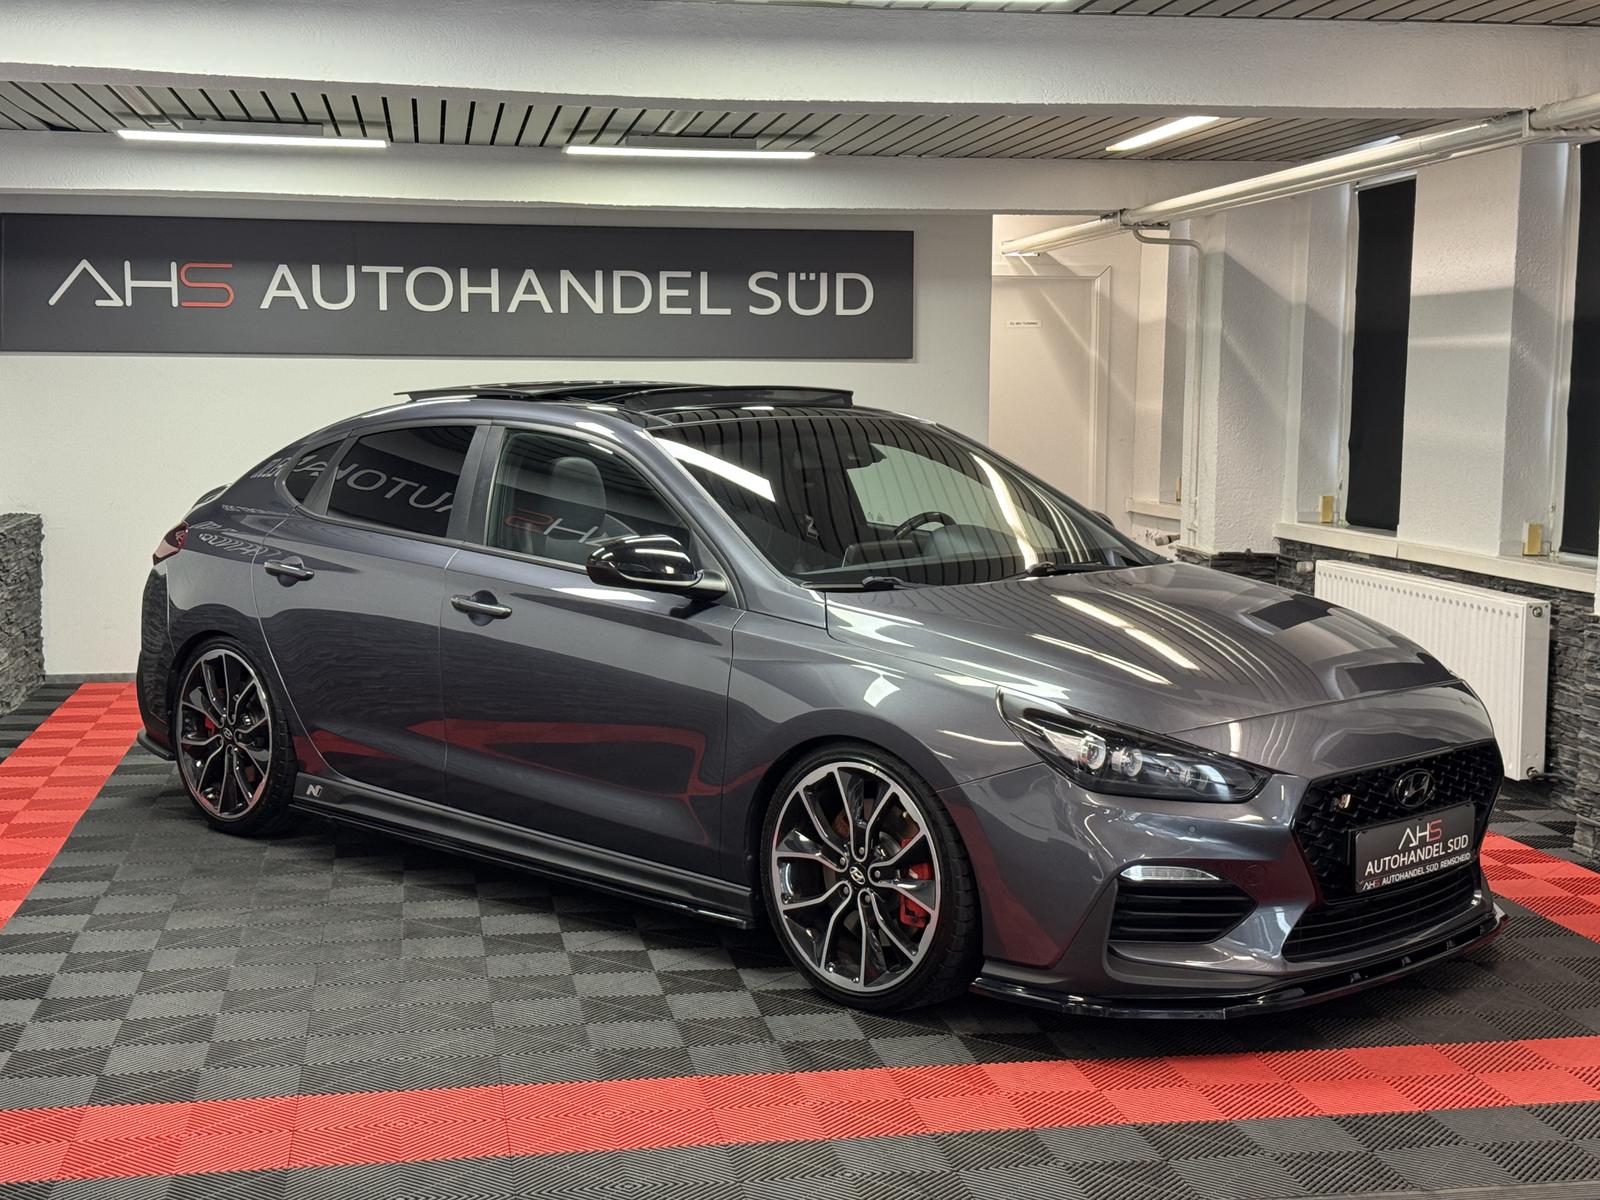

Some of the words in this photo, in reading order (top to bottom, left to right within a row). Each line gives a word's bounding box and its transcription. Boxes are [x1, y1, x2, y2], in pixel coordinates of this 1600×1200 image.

[48, 258, 235, 308] AHS
[259, 263, 732, 316] AUTOHANDEL
[747, 271, 875, 317] SÜD
[1398, 819, 1442, 850] AHS
[1364, 842, 1446, 876] AUTOHANDEL
[1381, 867, 1425, 886] AUTOHANDEL
[1440, 852, 1471, 869] REMSCHEID
